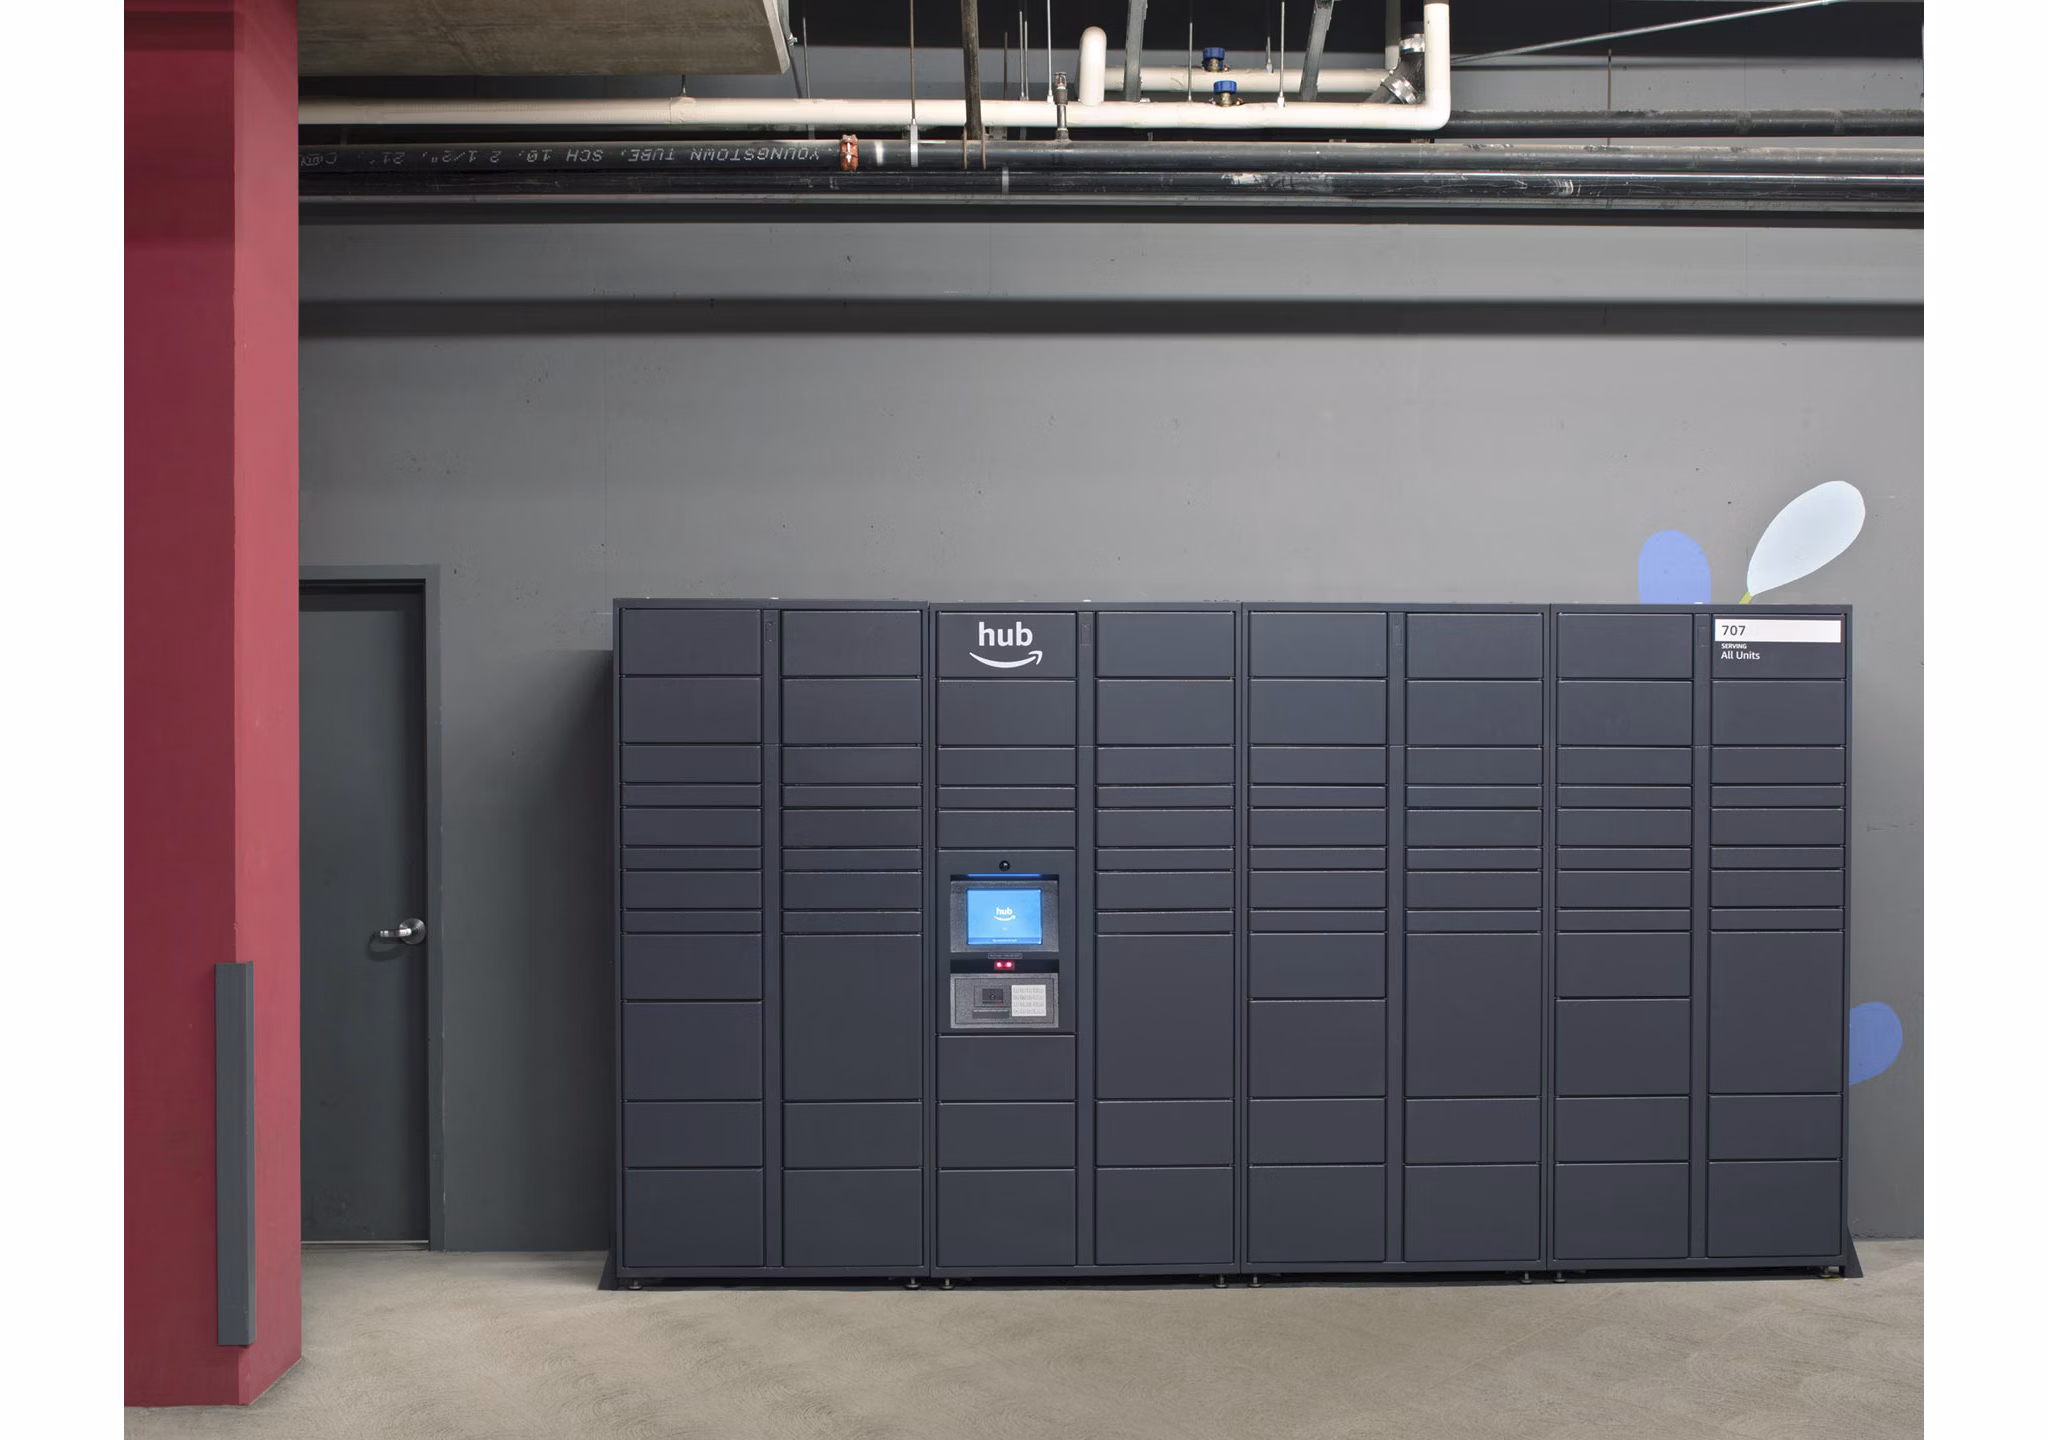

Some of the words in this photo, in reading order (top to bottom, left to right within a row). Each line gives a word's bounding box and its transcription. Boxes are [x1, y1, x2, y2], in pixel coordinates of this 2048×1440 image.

[490, 150, 502, 163] 2
[566, 149, 604, 162] SCH
[690, 148, 820, 161] YOUNGSTOWN
[978, 621, 1033, 647] hub
[1721, 625, 1746, 636] 707
[1720, 651, 1734, 660] All
[1736, 651, 1760, 660] Units
[996, 907, 1013, 915] hub
